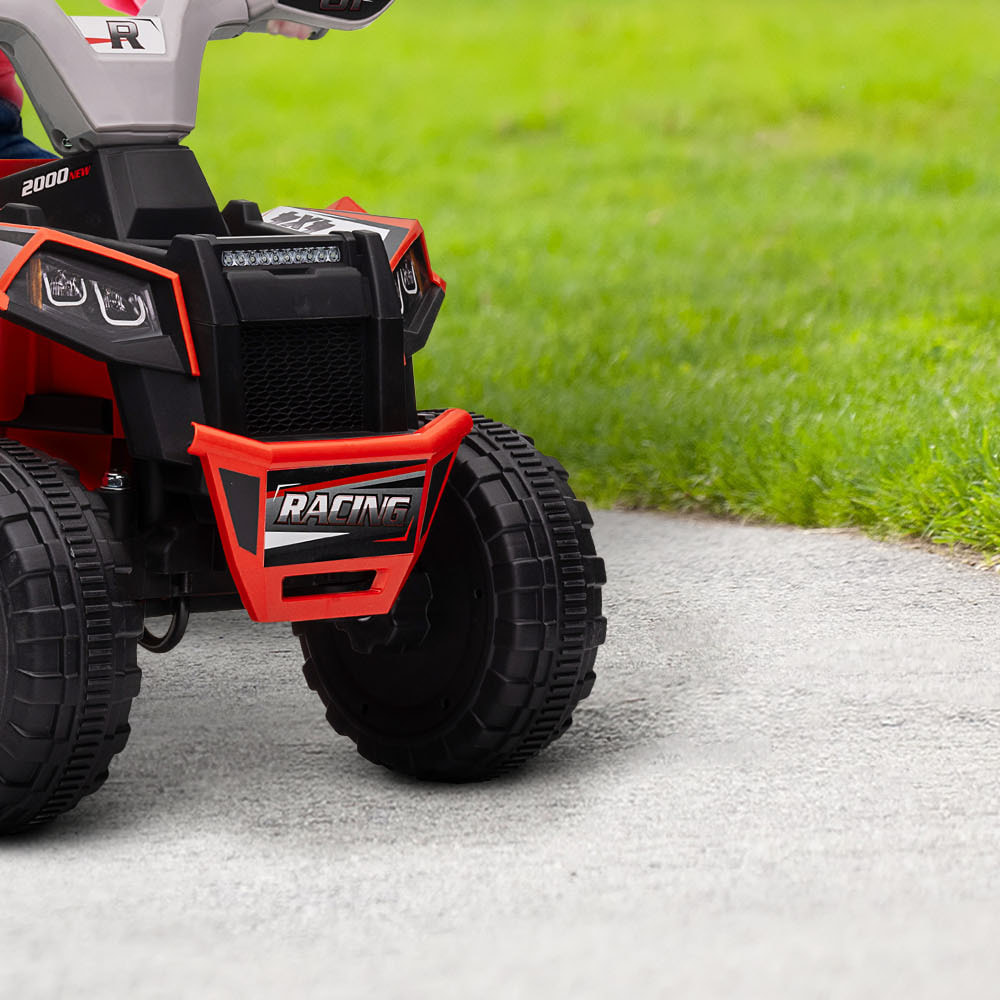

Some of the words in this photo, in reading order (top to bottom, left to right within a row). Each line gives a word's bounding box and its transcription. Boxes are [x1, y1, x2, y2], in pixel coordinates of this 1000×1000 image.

[106, 20, 146, 50] R
[21, 167, 70, 198] 2000
[274, 492, 413, 526] RACING
